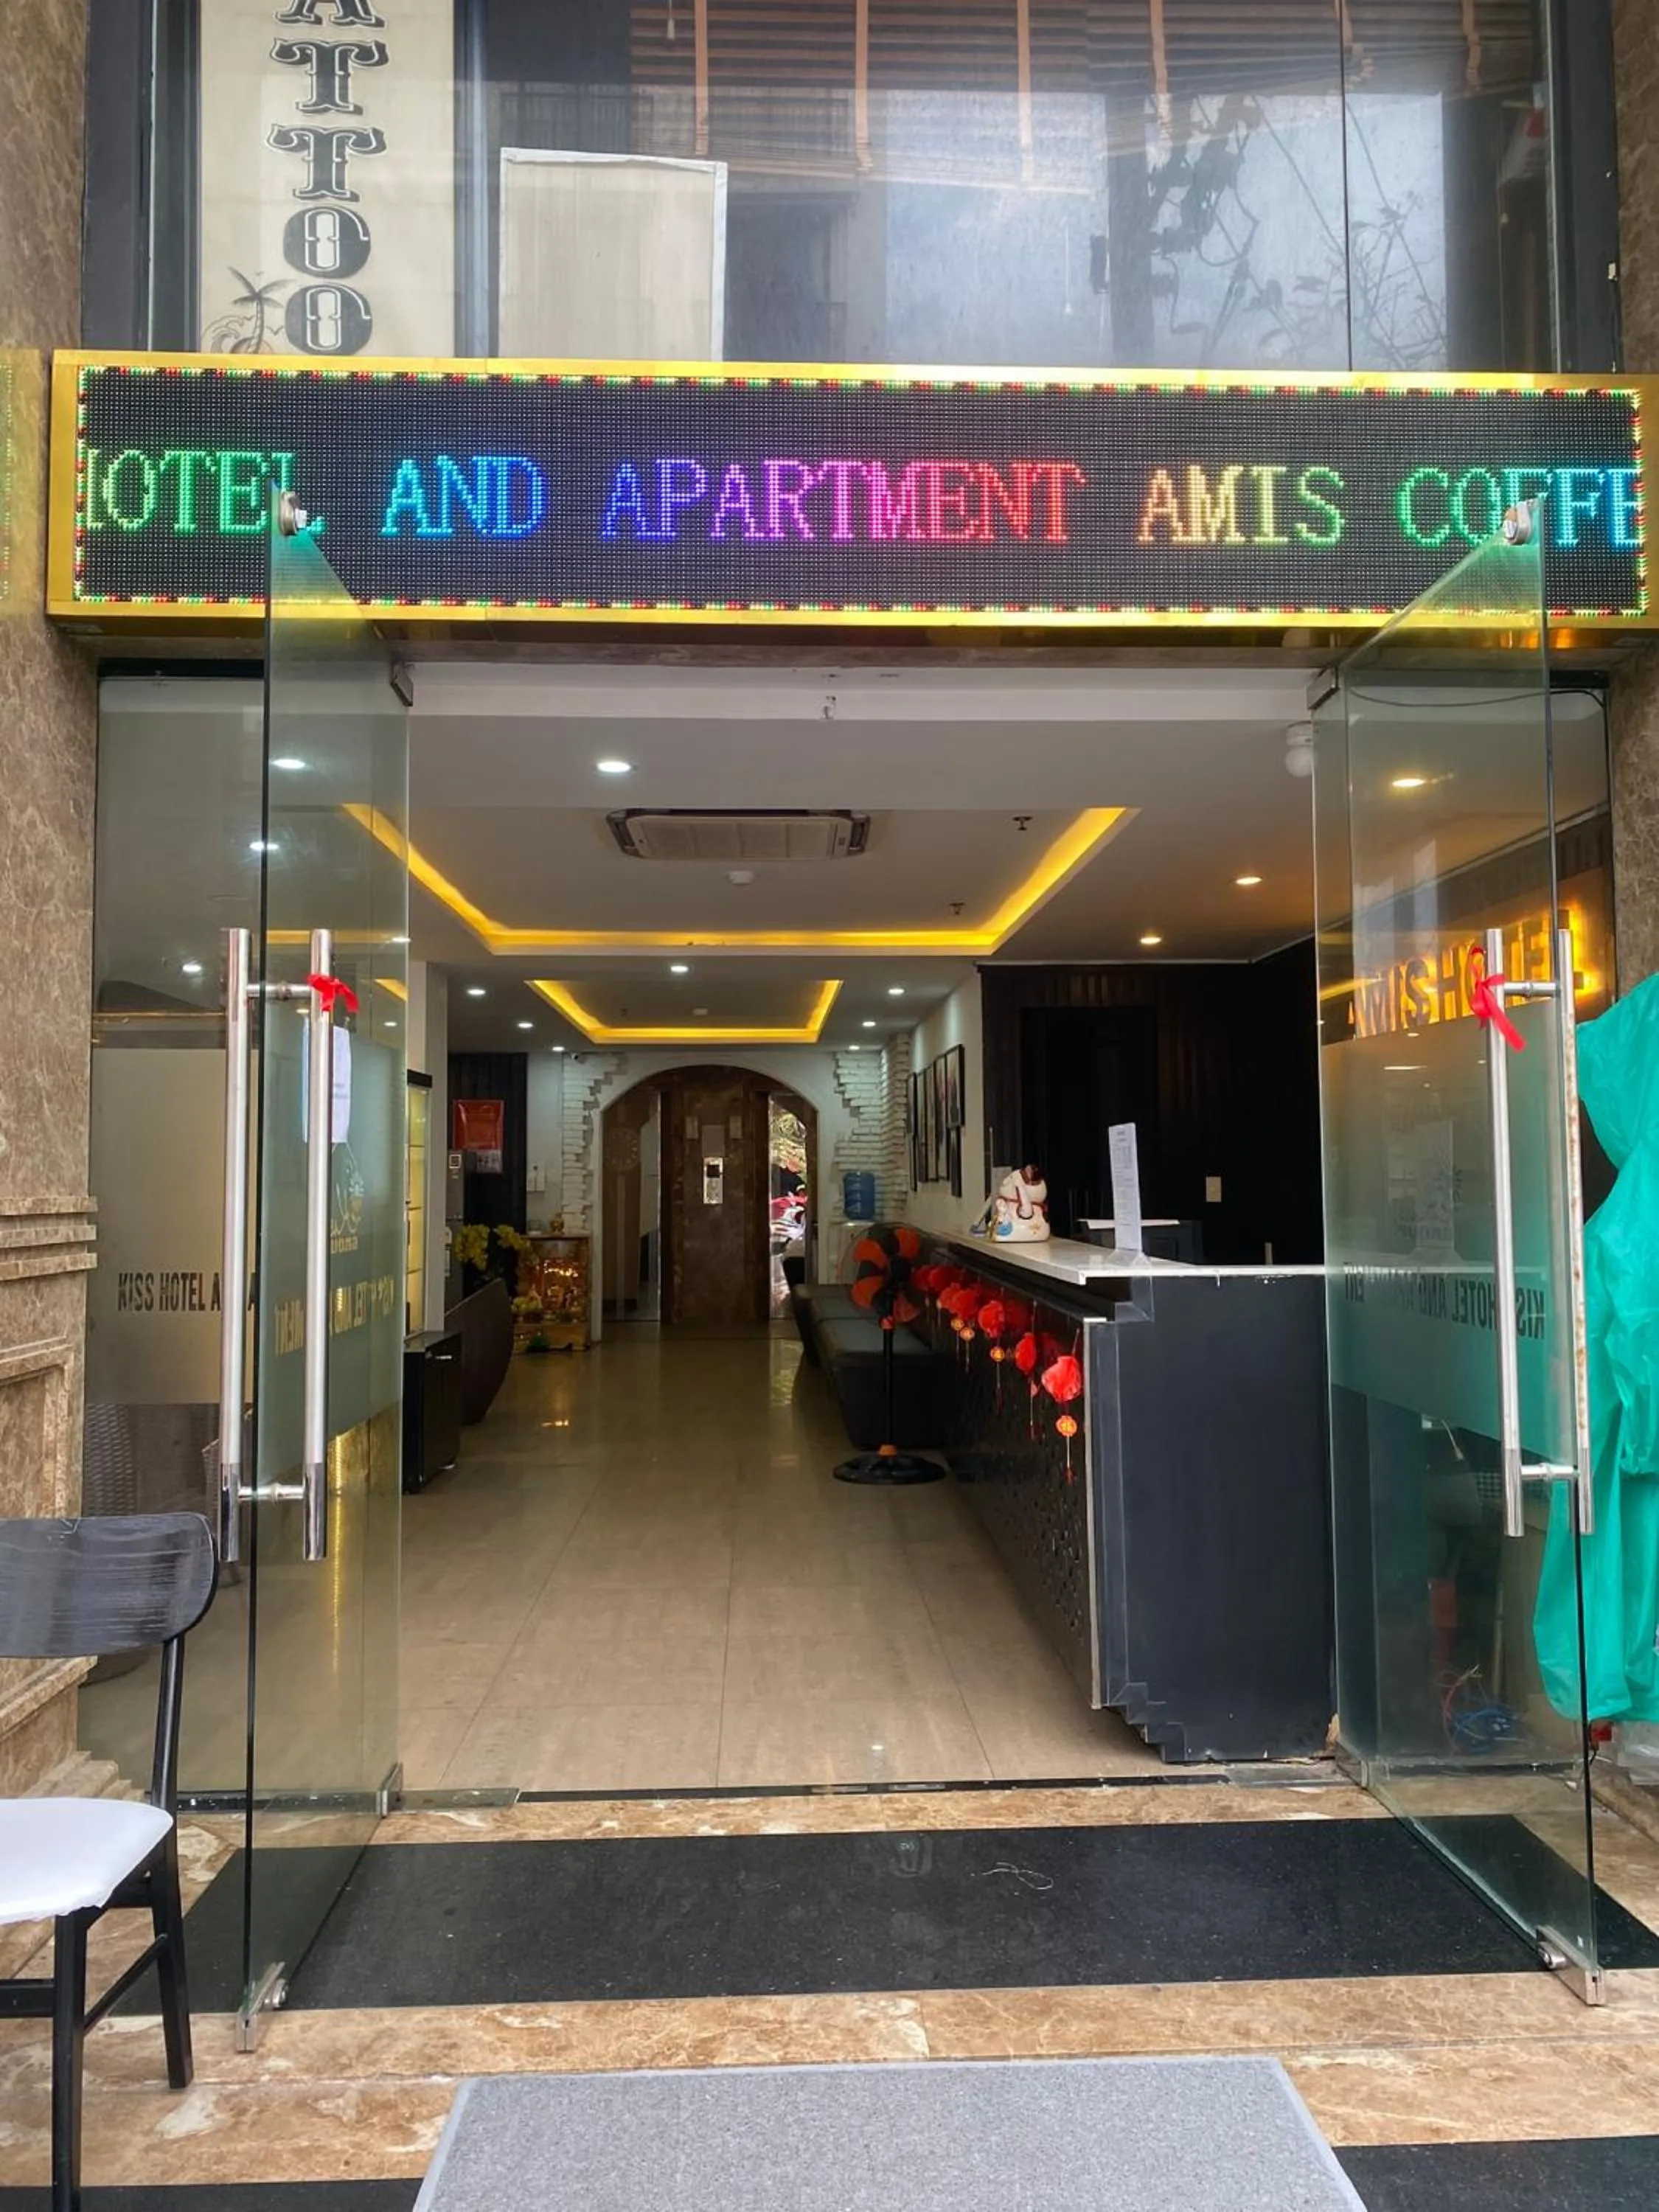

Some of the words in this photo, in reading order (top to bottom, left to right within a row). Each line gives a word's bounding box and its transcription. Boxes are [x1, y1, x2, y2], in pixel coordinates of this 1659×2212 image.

[380, 454, 548, 539] AND
[600, 459, 1086, 542] APARTMENT
[1138, 465, 1346, 546] AMIS
[117, 1272, 154, 1312] KISS
[159, 1272, 206, 1312] HOTEL
